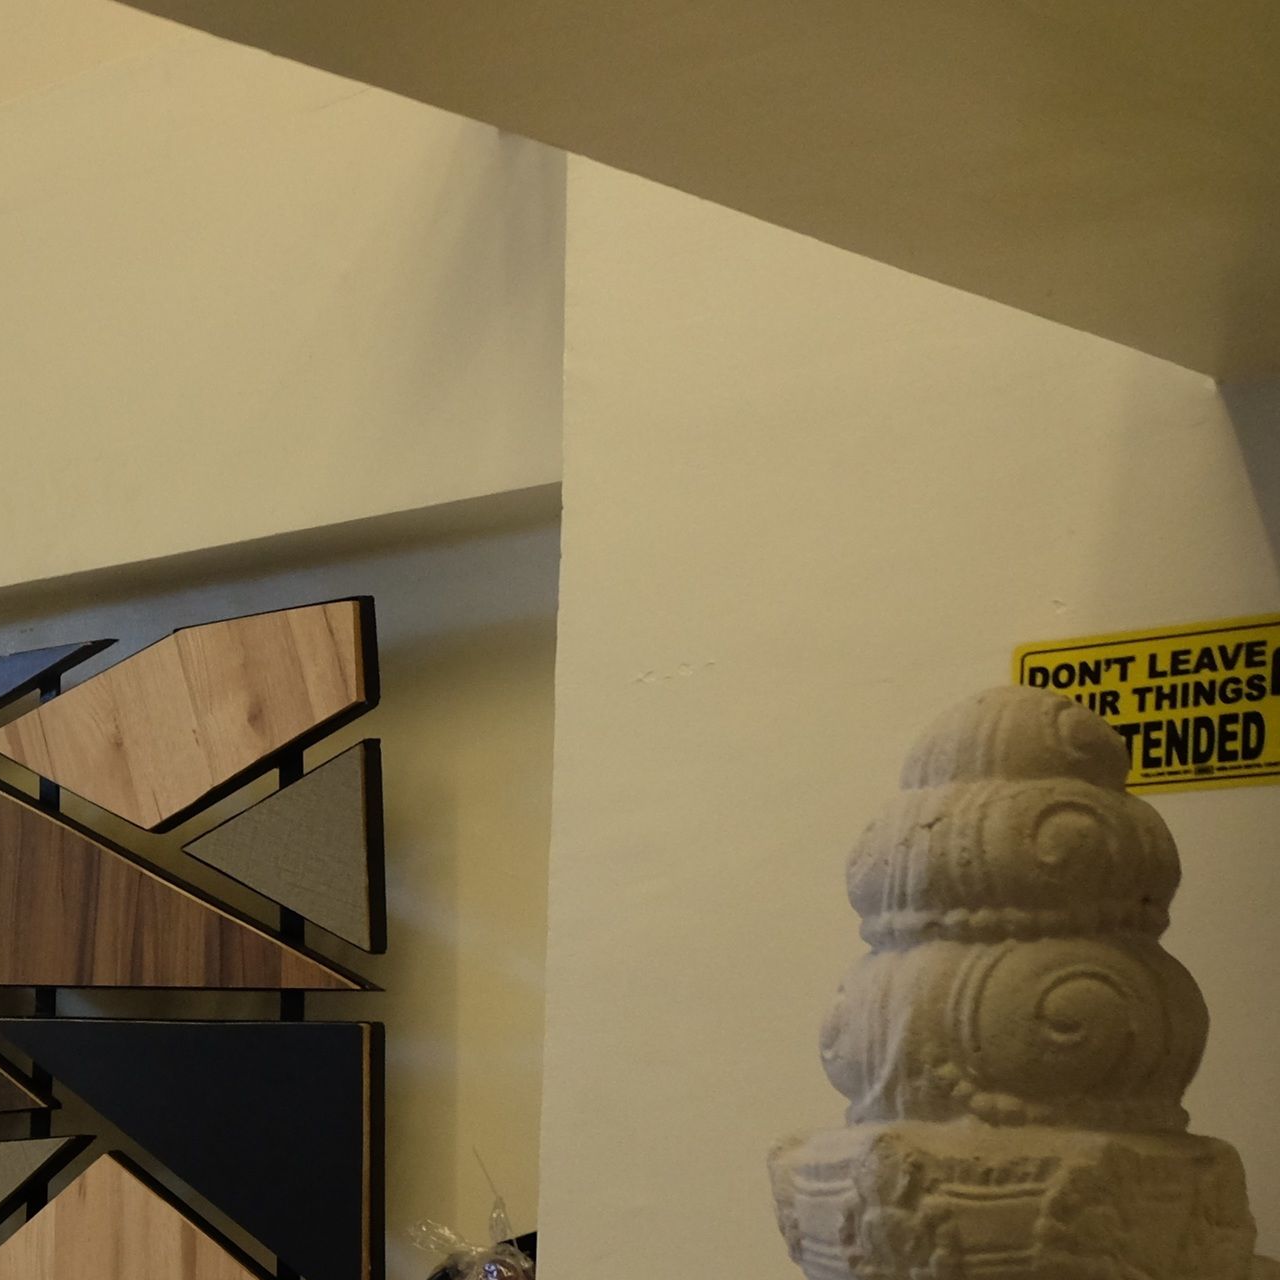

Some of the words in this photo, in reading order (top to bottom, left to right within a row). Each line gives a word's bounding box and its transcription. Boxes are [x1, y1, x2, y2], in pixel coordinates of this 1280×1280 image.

[1028, 656, 1136, 689] DON'T
[1148, 640, 1268, 678] LEAVE
[1132, 673, 1267, 713] THINGS
[1113, 711, 1266, 769] TENDED
